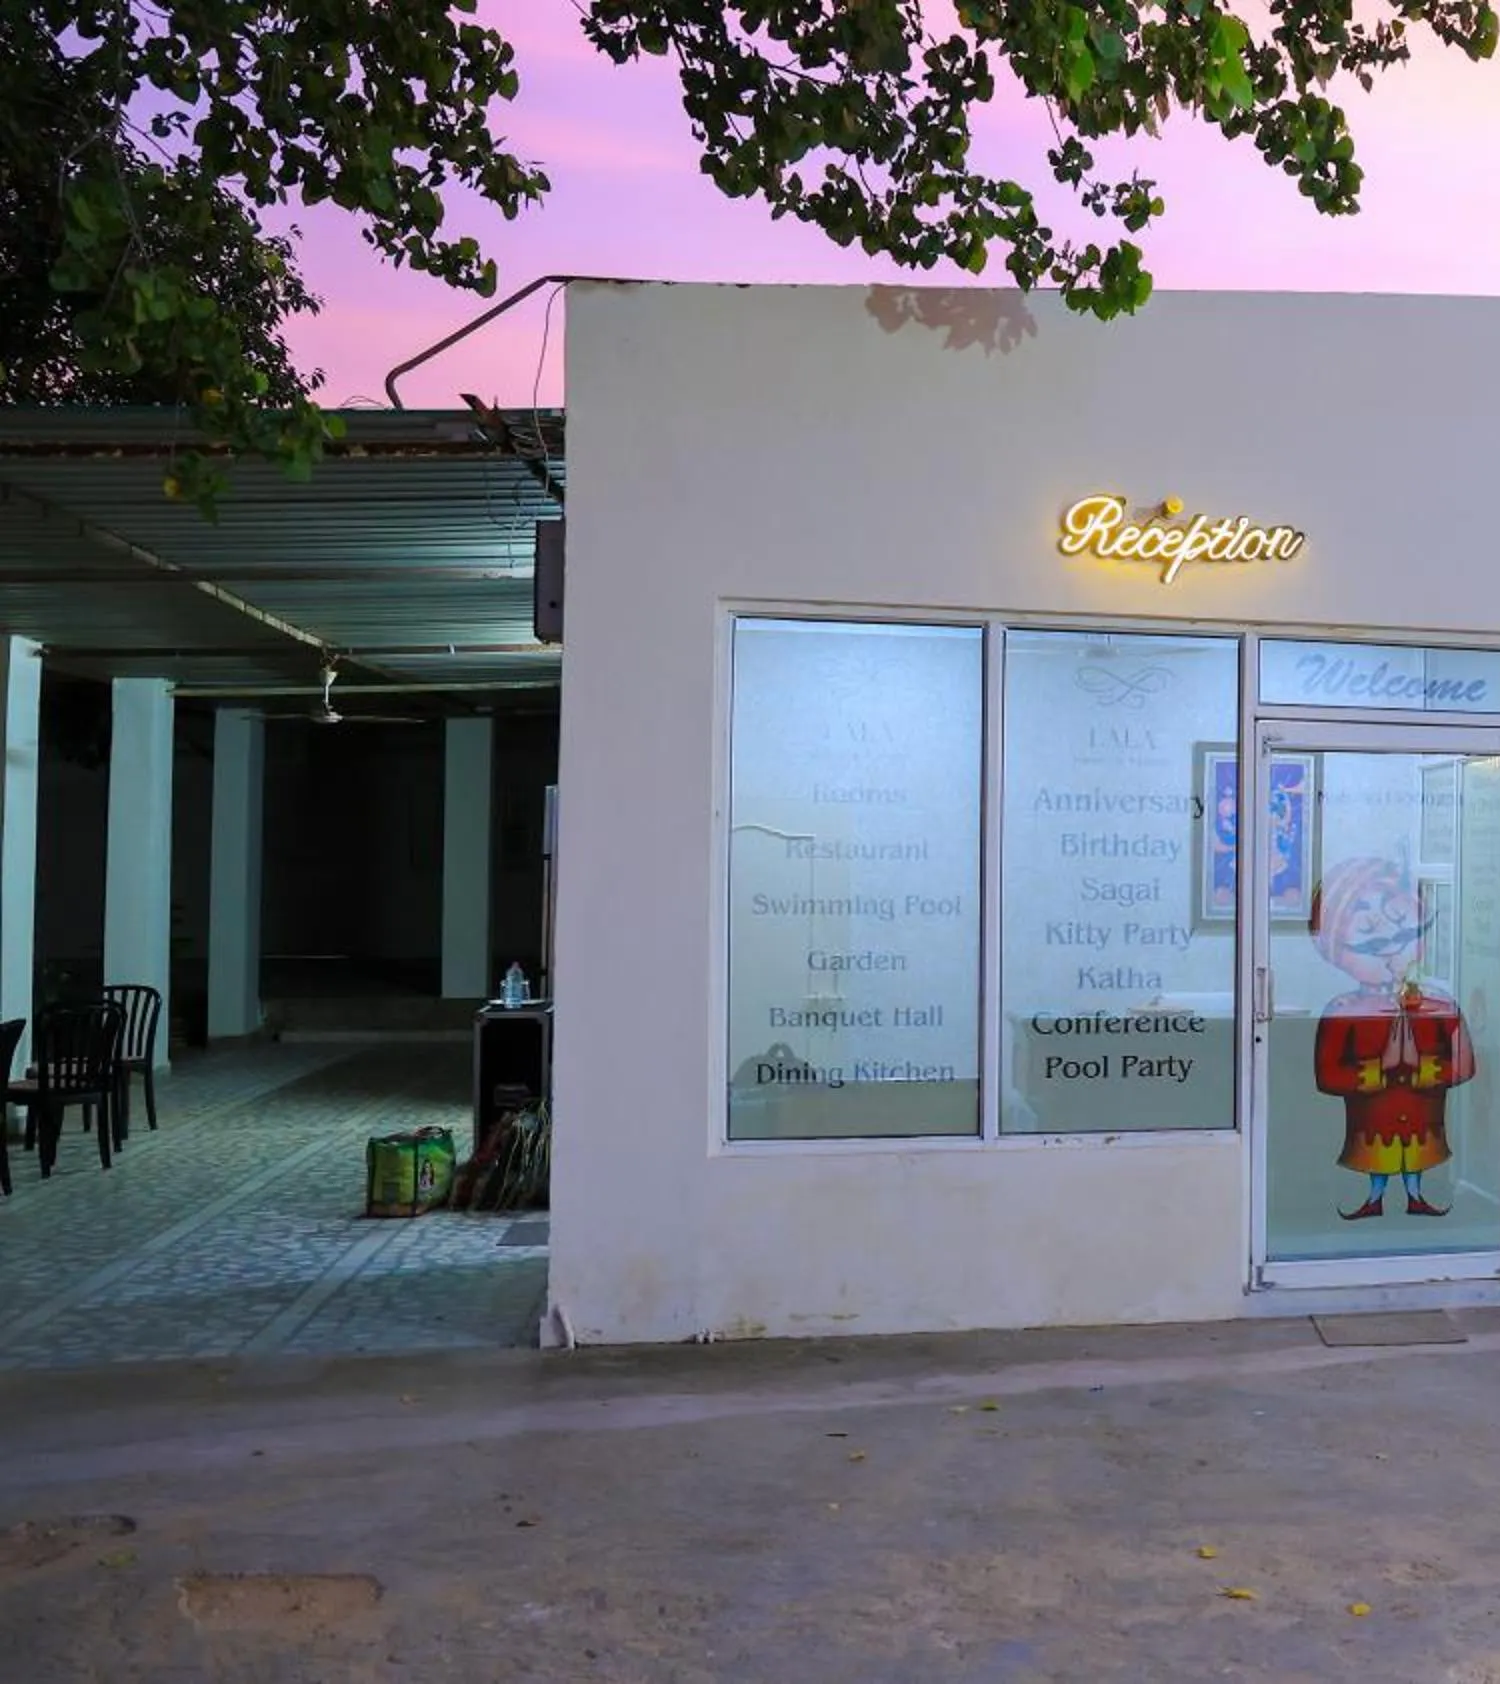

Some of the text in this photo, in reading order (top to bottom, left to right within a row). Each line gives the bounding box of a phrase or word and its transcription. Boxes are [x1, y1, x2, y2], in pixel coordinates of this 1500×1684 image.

[1059, 494, 1306, 583] Reception
[1297, 653, 1487, 702] Welcome
[813, 782, 907, 806] Rooms
[1033, 785, 1205, 819] Anniversary
[785, 837, 929, 861] Restaurant
[1060, 834, 1182, 861] Birthday
[1080, 876, 1161, 905] Sagai
[751, 893, 961, 920] Swimming Pool
[1045, 921, 1195, 949] Kitty Party
[806, 950, 908, 973] Garden
[1077, 967, 1163, 991] Katha
[769, 1004, 944, 1031] Banquet Hall
[1031, 1012, 1206, 1036] Conference
[756, 1060, 955, 1089] Dining Kitchen
[1045, 1055, 1193, 1083] Pool Party
